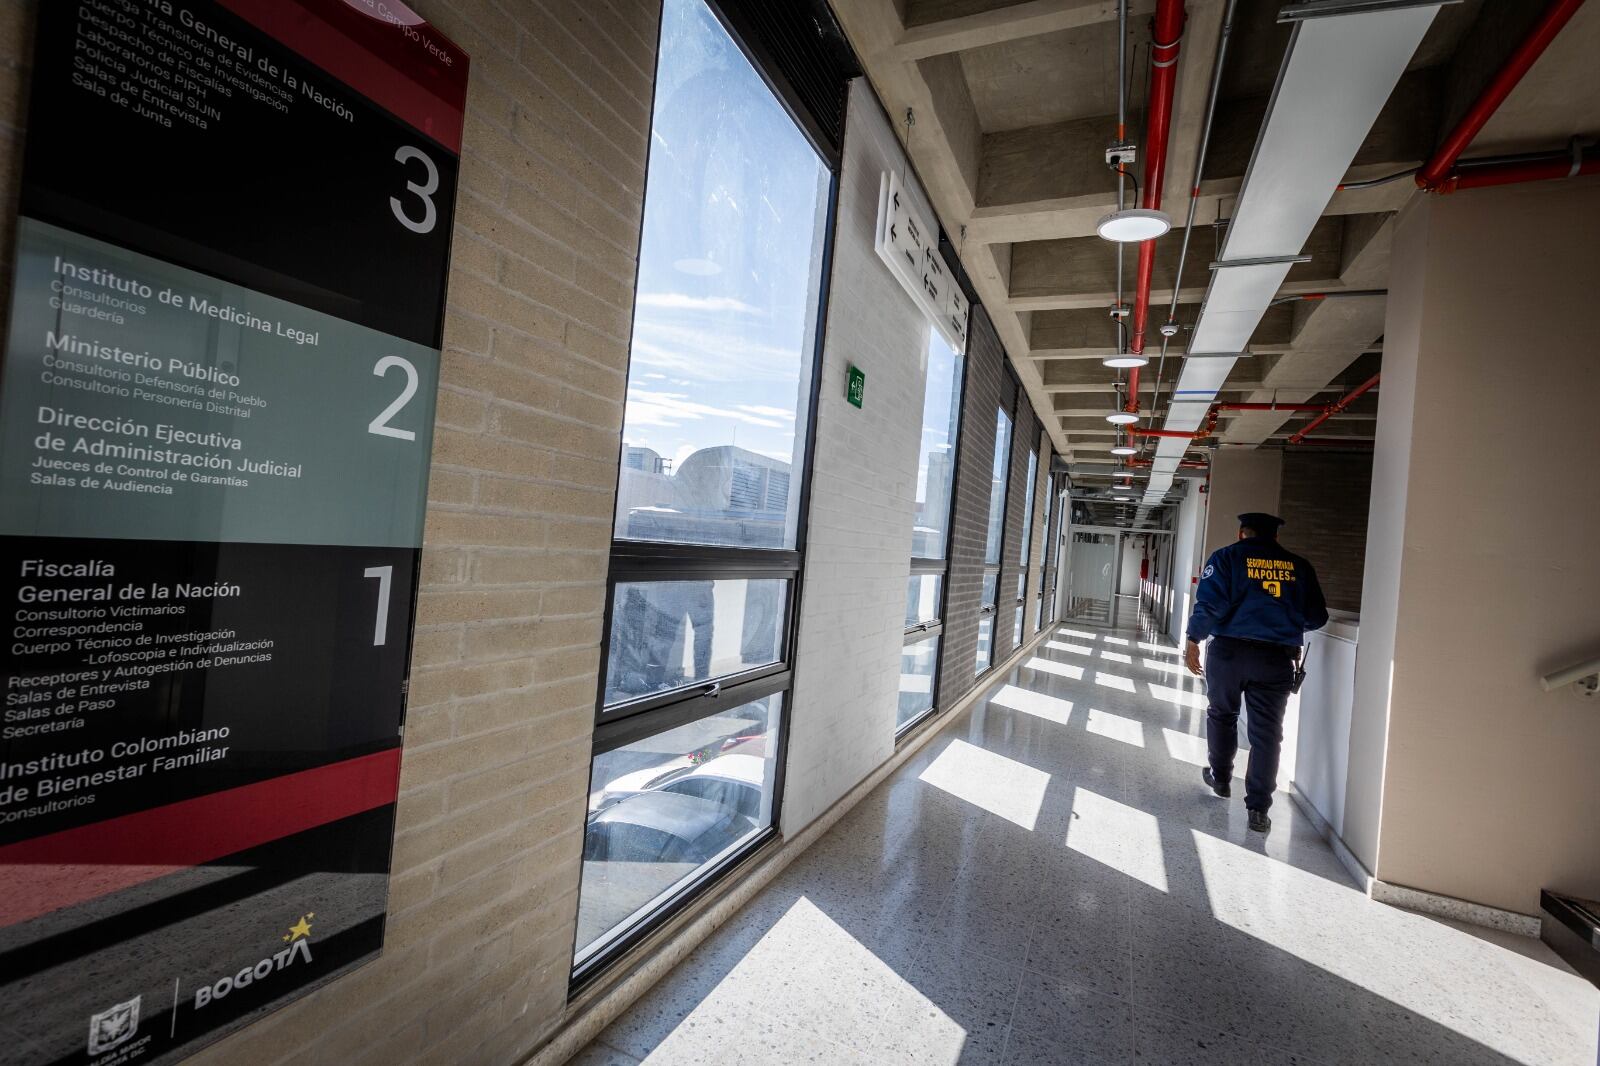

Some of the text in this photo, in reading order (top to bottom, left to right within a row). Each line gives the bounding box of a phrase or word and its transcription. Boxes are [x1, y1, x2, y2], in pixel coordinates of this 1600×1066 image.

[78, 6, 154, 55] Despacho
[158, 51, 175, 66] de
[178, 60, 232, 98] Fiscalías
[145, 8, 294, 103] Transitoria de Evidencias
[378, 2, 452, 66] Campo Verde
[77, 23, 206, 99] Laboratorios PIPH
[140, 22, 192, 60] Técnico
[196, 57, 211, 70] de
[214, 65, 288, 114] Investigación
[180, 10, 354, 123] General de la Nación
[72, 72, 172, 128] Sala de Junta
[74, 56, 208, 130] Salas de Entrevista
[130, 70, 184, 102] Judicial
[186, 96, 221, 121] SIJIN
[390, 146, 439, 234] 3
[48, 296, 124, 325] Guardería
[50, 279, 146, 315] Consultorios
[54, 256, 319, 346] Instituto de Medicina Legal
[42, 354, 267, 407] Consultorio Defensoría del Pueblo
[46, 331, 240, 387] Ministerio Público
[41, 371, 251, 418] Consultorio Personería Distrital
[368, 355, 419, 441] 2
[37, 406, 242, 450] Dirección Ejecutiva
[32, 455, 248, 487] Jueces de Control de Garantías
[34, 432, 302, 478] de Administración Judicial
[30, 471, 173, 495] Salas de Audiencia
[20, 559, 116, 578] Fiscalía
[1246, 558, 1294, 571] SEGURIDAD PRIVADA
[1248, 568, 1290, 581] NAPOLES
[15, 603, 186, 622] Consultorio Victimarios
[18, 582, 241, 603] General de la Nación
[364, 565, 393, 646] 1
[12, 628, 236, 657] Cuerpo Técnico de Investigación
[13, 620, 144, 640] Correspondencia
[169, 648, 177, 656] e
[180, 638, 274, 656] Individualización
[6, 678, 150, 706] Salas de Entrevista
[8, 652, 272, 689] Receptores y Autogestión de Denuncias
[2, 716, 85, 740] Secretaría
[4, 698, 116, 723] Salas de Paso
[0, 726, 230, 780] Instituto Colombiano
[0, 744, 230, 806] de Bienestar Familiar
